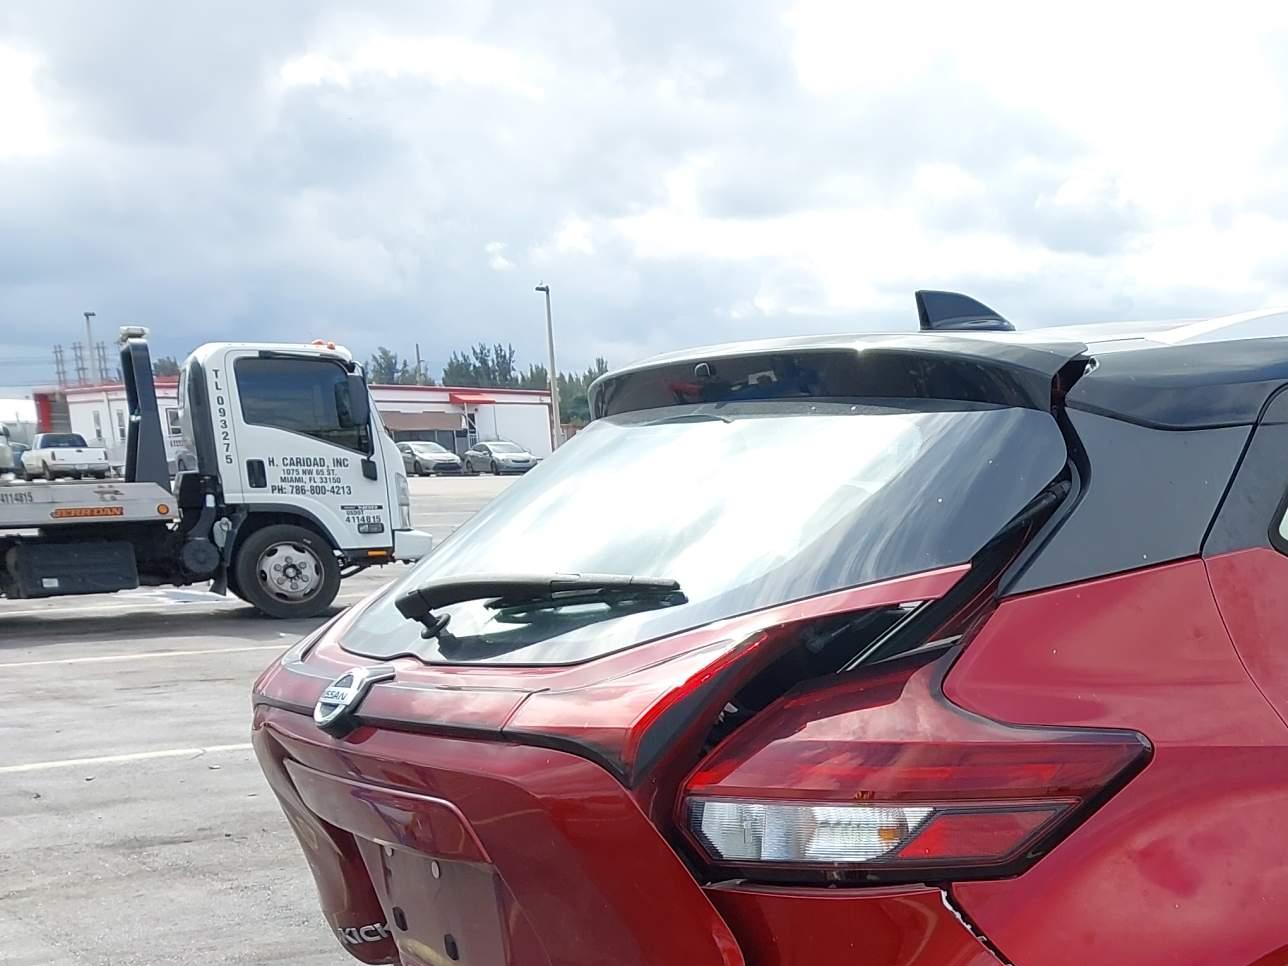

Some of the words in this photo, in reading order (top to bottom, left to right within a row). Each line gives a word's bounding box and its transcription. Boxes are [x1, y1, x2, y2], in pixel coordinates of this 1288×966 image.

[211, 368, 234, 465] TL093275
[267, 456, 279, 468] H.
[332, 457, 350, 468] INC
[282, 468, 300, 476] 1075
[301, 468, 314, 476] NW
[280, 476, 307, 484] MIAMI,
[308, 476, 318, 484] FL
[319, 476, 342, 484] 33150
[271, 484, 287, 495] PH:
[289, 484, 352, 496] 786-800-4213
